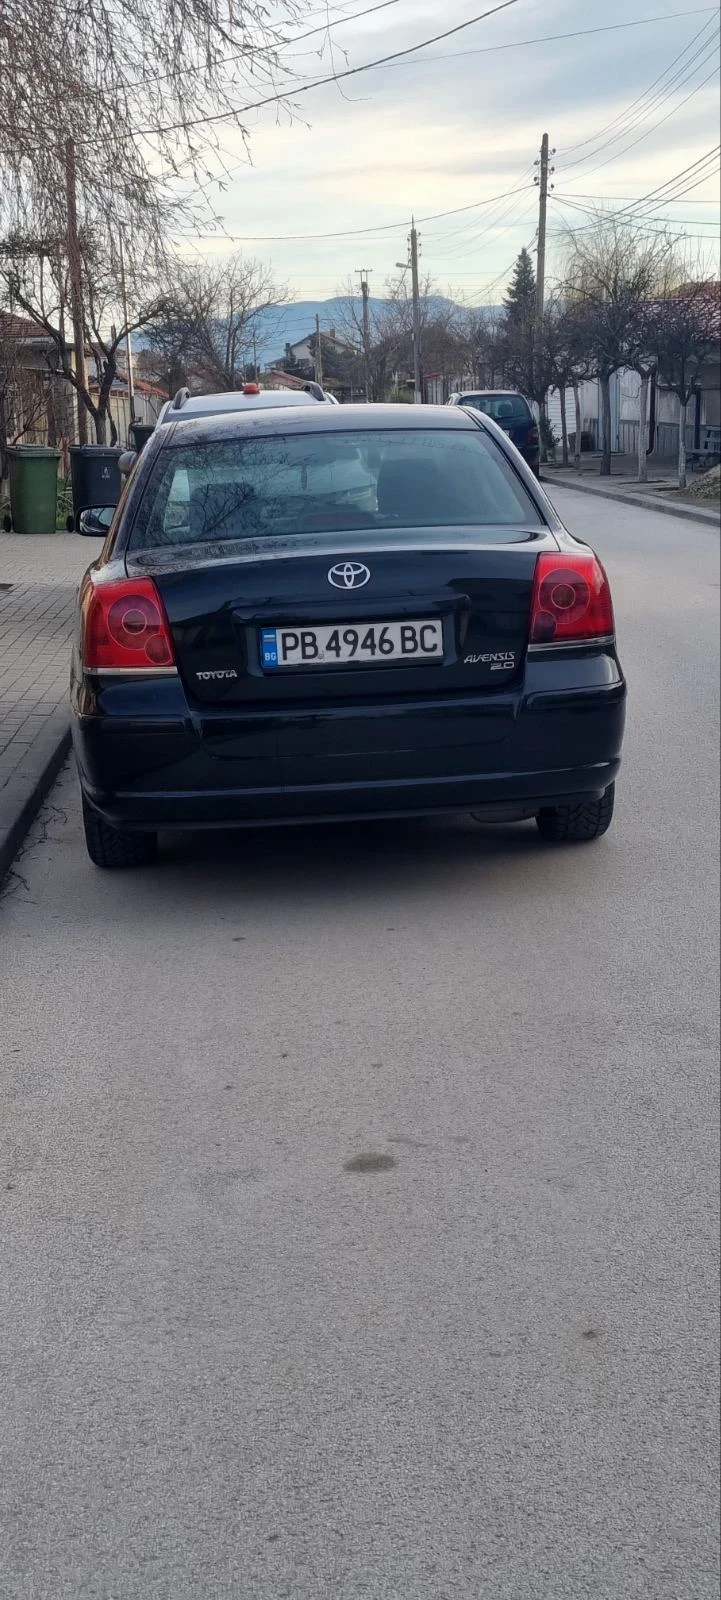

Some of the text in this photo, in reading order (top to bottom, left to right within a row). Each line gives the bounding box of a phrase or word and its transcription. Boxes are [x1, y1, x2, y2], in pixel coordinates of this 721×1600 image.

[281, 624, 438, 661] PB 4946 BC
[264, 652, 277, 661] BG
[463, 651, 516, 664] AVENSIS
[196, 669, 238, 681] TOYOTA
